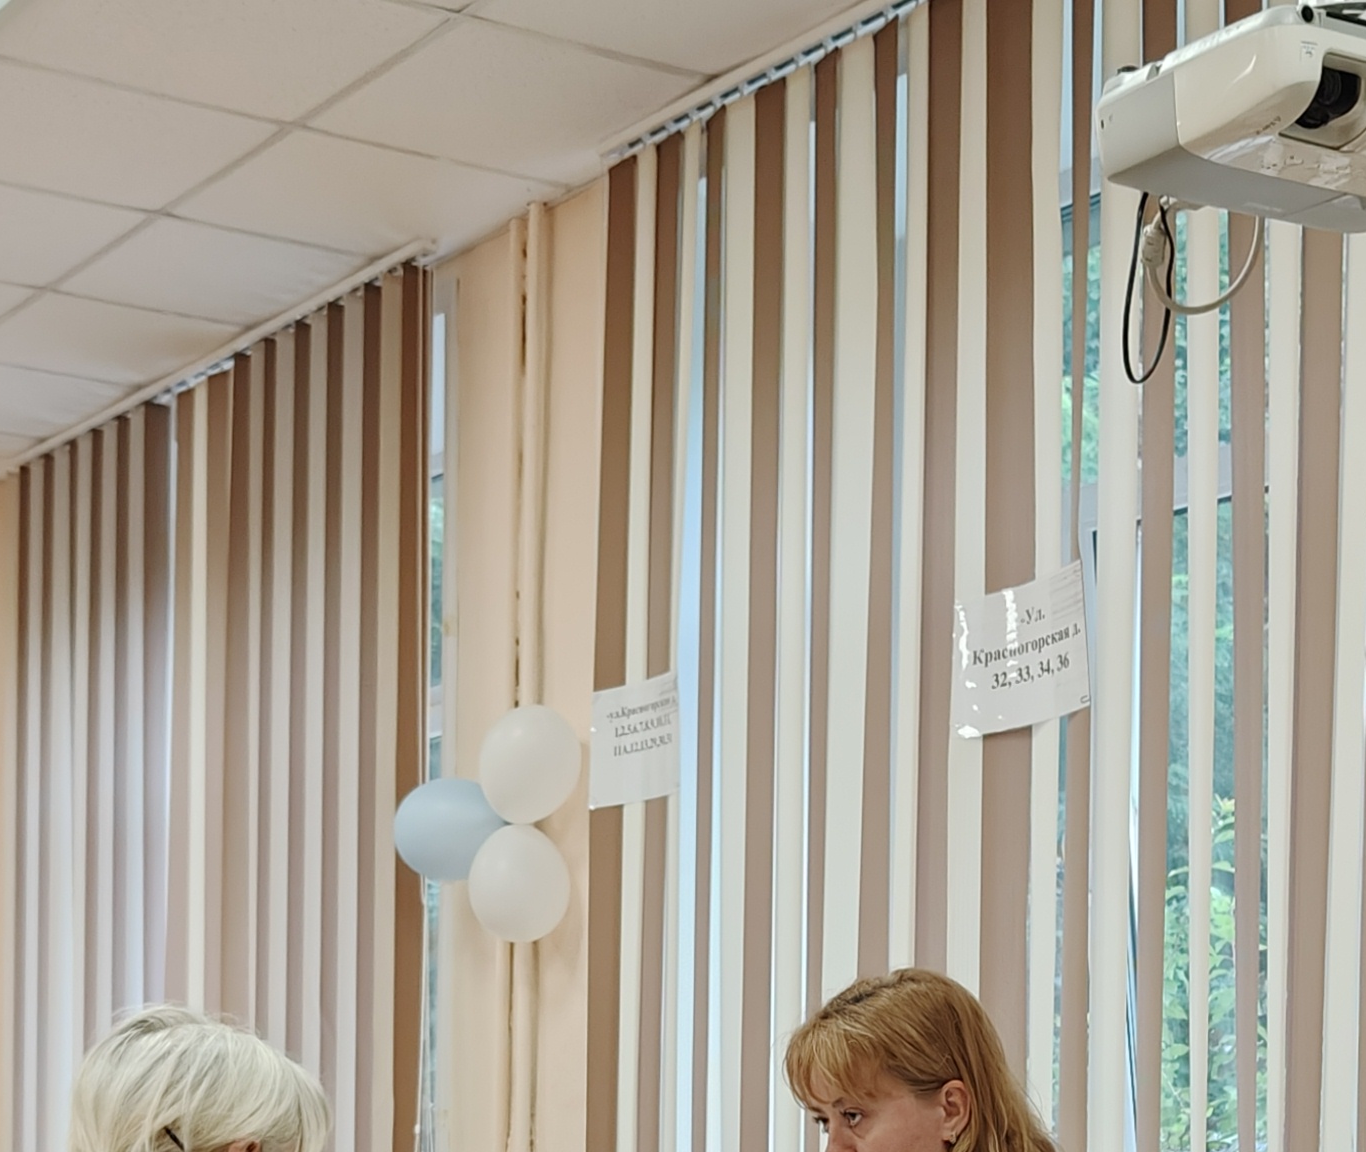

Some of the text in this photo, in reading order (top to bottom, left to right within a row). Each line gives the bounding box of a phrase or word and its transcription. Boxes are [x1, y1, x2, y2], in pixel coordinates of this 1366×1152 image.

[973, 627, 1070, 668] Красногорская
[991, 652, 1070, 690] 32, 33, 34, 36
